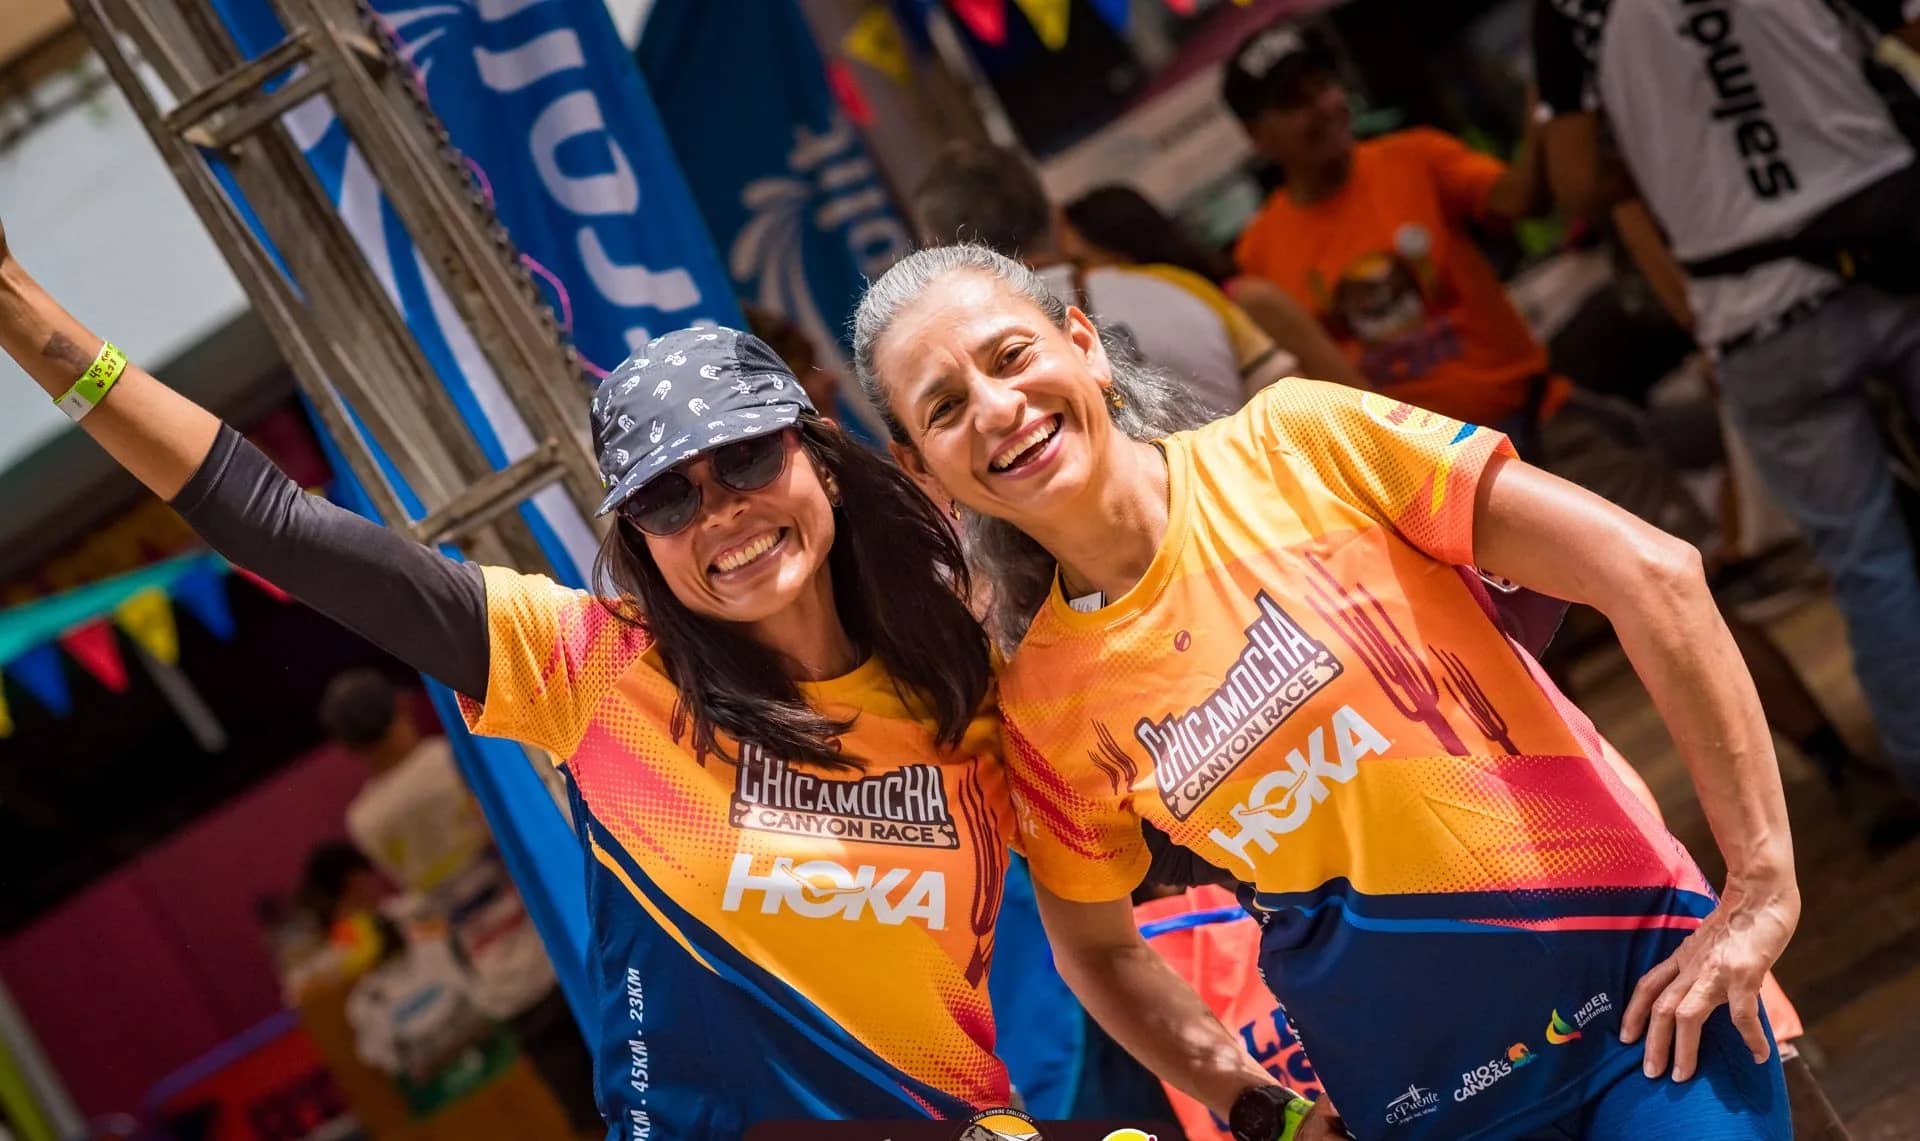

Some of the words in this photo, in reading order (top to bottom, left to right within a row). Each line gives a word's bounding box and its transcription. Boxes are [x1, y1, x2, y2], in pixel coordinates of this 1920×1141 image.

[1676, 0, 1798, 198] salmó
[89, 364, 103, 379] 45
[1137, 595, 1317, 793] CHICAMOCHA
[1183, 726, 1264, 802] CANYON
[1264, 671, 1319, 727] RACE
[740, 741, 948, 822] CHICAMOCHA
[1207, 704, 1392, 870] HOKA
[759, 810, 864, 839] CANYON
[870, 822, 936, 844] RACE
[721, 852, 946, 931] HOKA
[627, 968, 645, 1023] 23KM
[1578, 1003, 1613, 1029] Santander
[628, 1040, 650, 1092] 45KM
[1454, 1062, 1512, 1102] CANOAS
[1462, 1060, 1500, 1086] RIOS
[630, 1109, 652, 1141] KM
